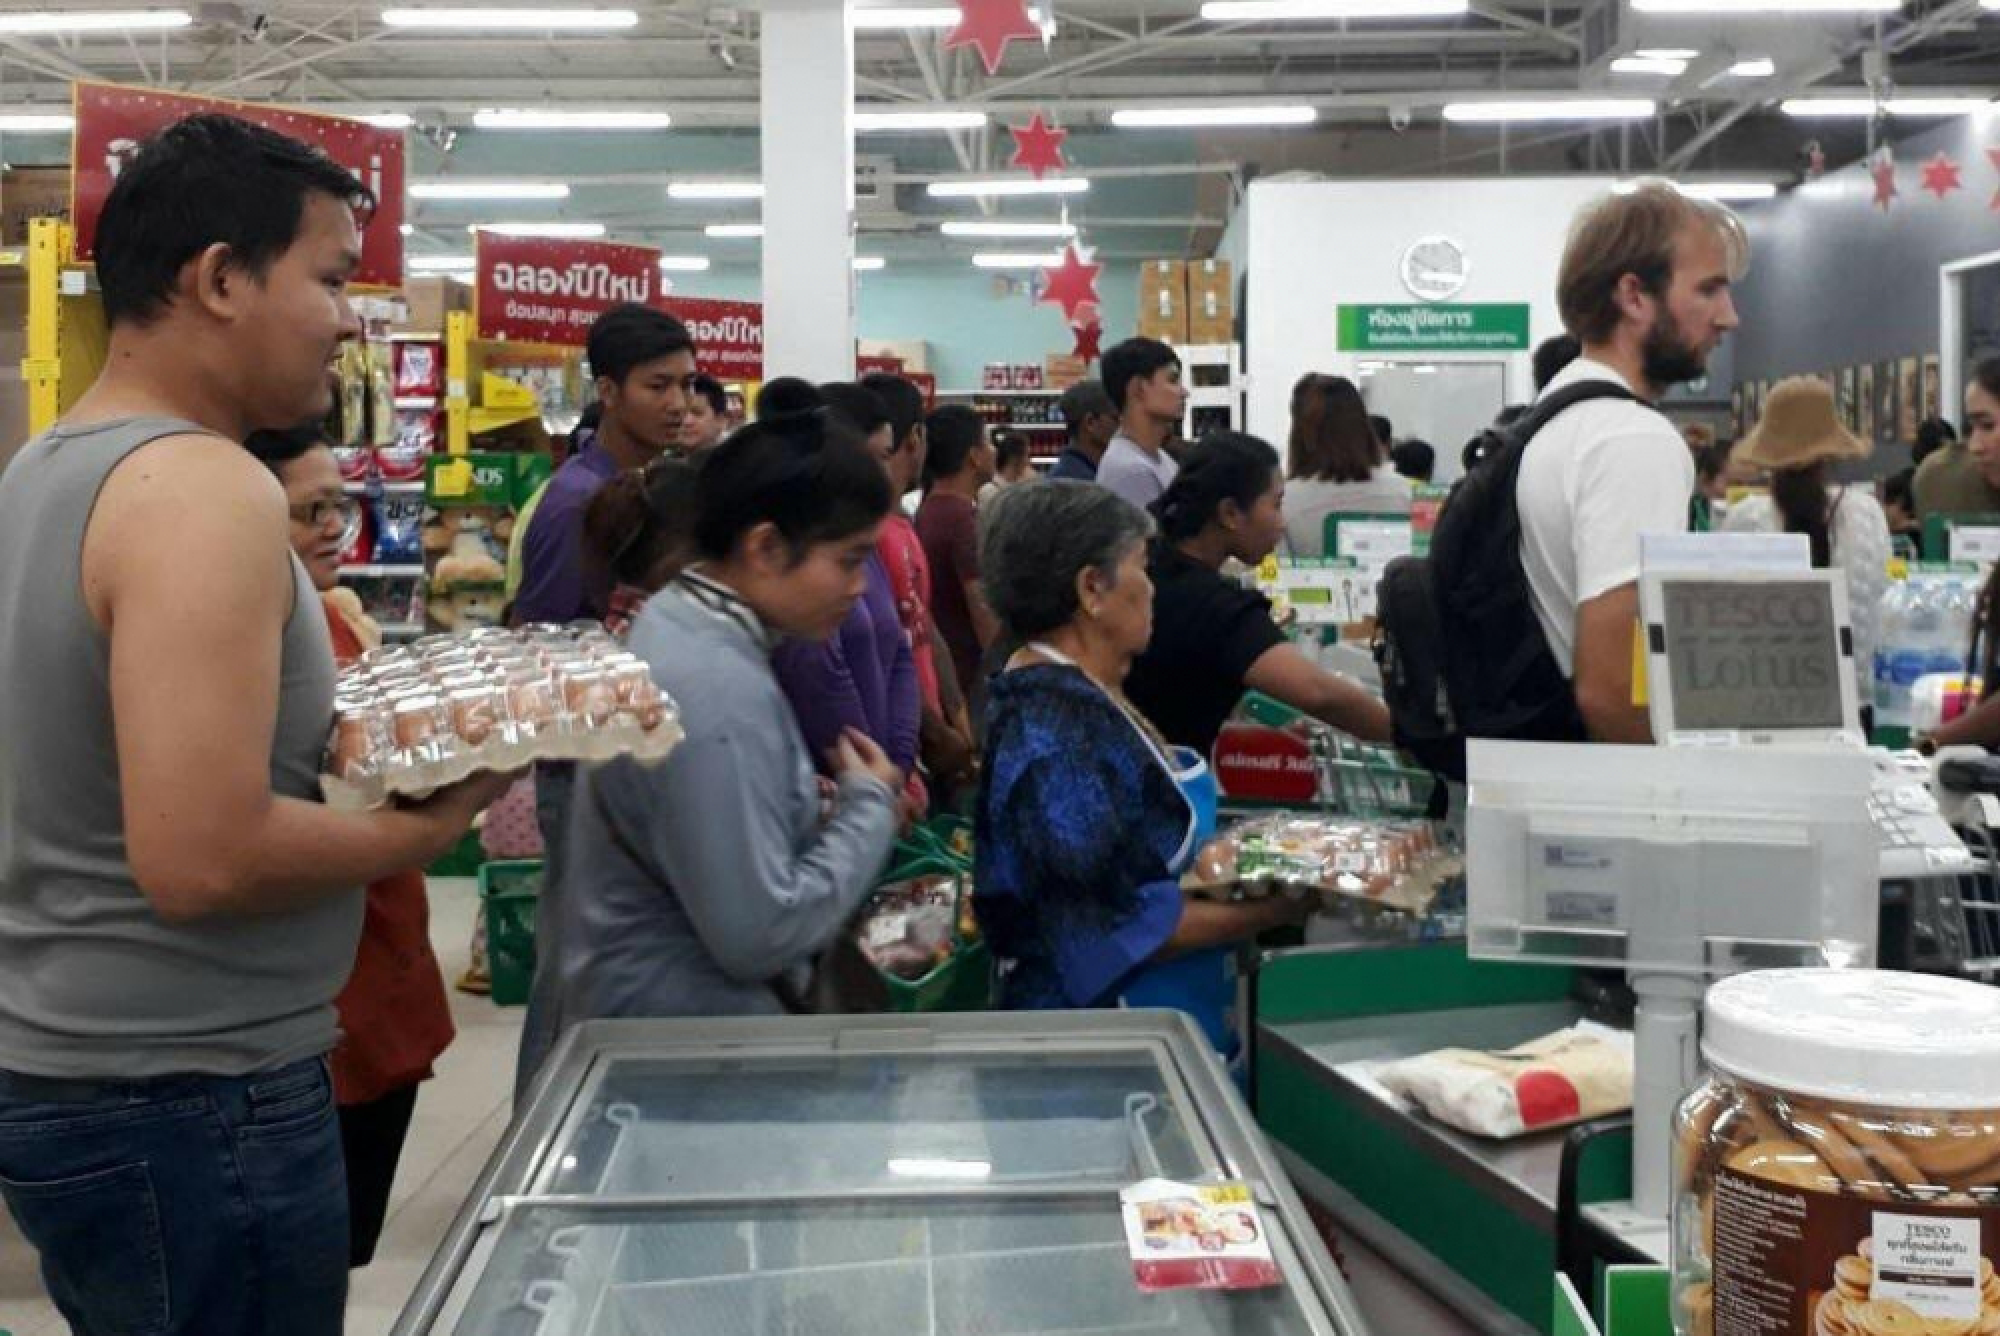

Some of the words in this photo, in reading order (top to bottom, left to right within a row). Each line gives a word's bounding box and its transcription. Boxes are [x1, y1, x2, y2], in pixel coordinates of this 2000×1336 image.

[492, 261, 649, 304] ฉลองปีใหม่
[1674, 593, 1824, 628] TESCO
[1684, 649, 1829, 691] Lotus
[1904, 1222, 1951, 1239] TESCO
